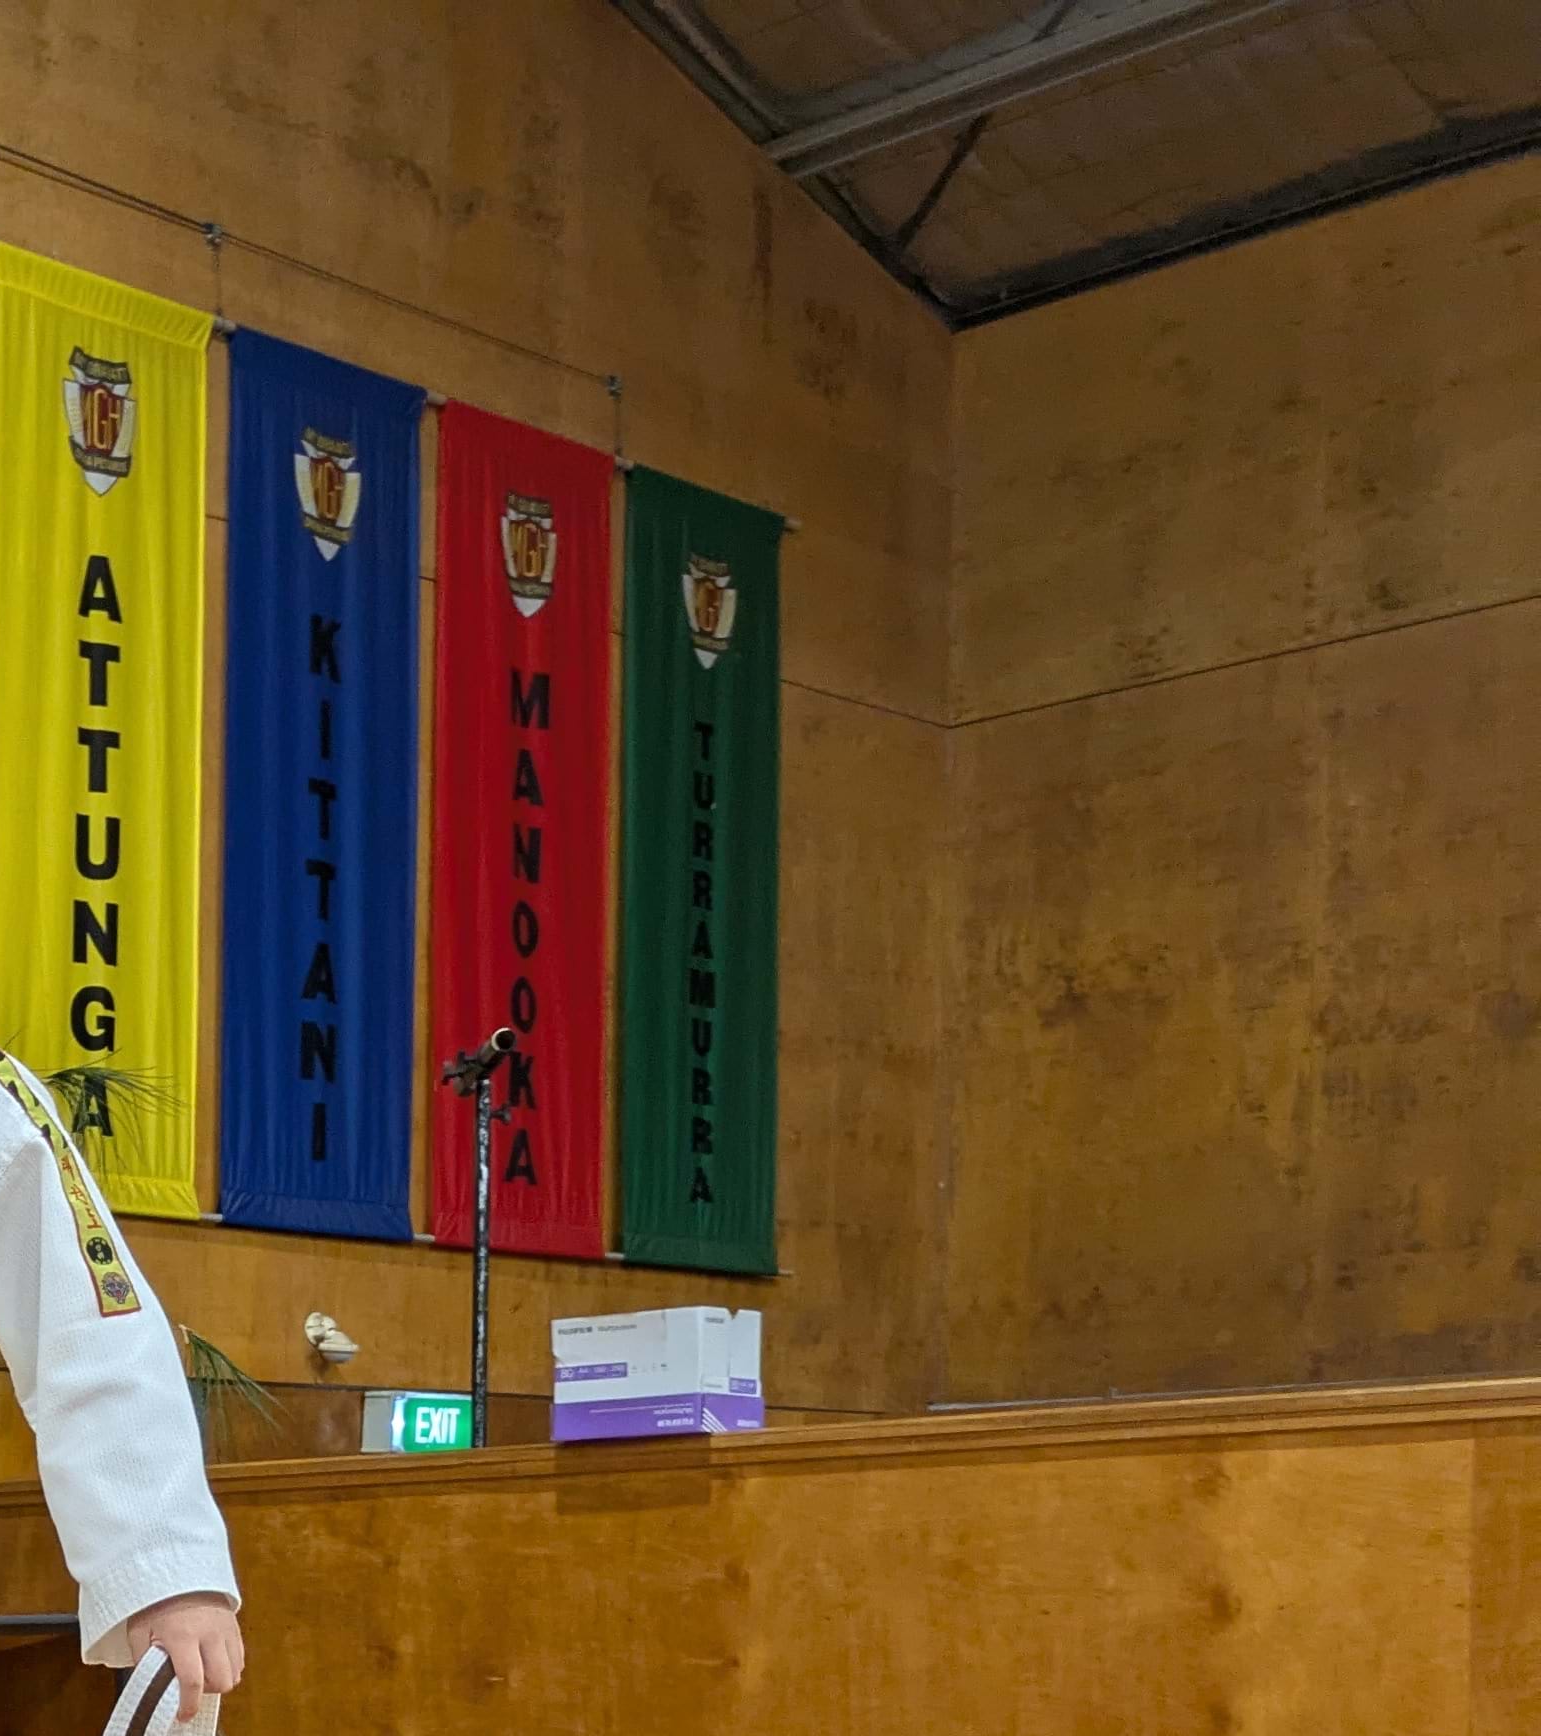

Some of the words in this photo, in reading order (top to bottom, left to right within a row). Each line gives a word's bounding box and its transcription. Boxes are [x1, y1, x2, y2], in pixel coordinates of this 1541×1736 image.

[69, 554, 123, 1138] ATTUNGA
[300, 613, 342, 1162] KITTANI
[503, 668, 551, 1186] MANOOKA
[688, 721, 717, 1202] TURRAMURRA
[415, 1406, 461, 1444] EXIT
